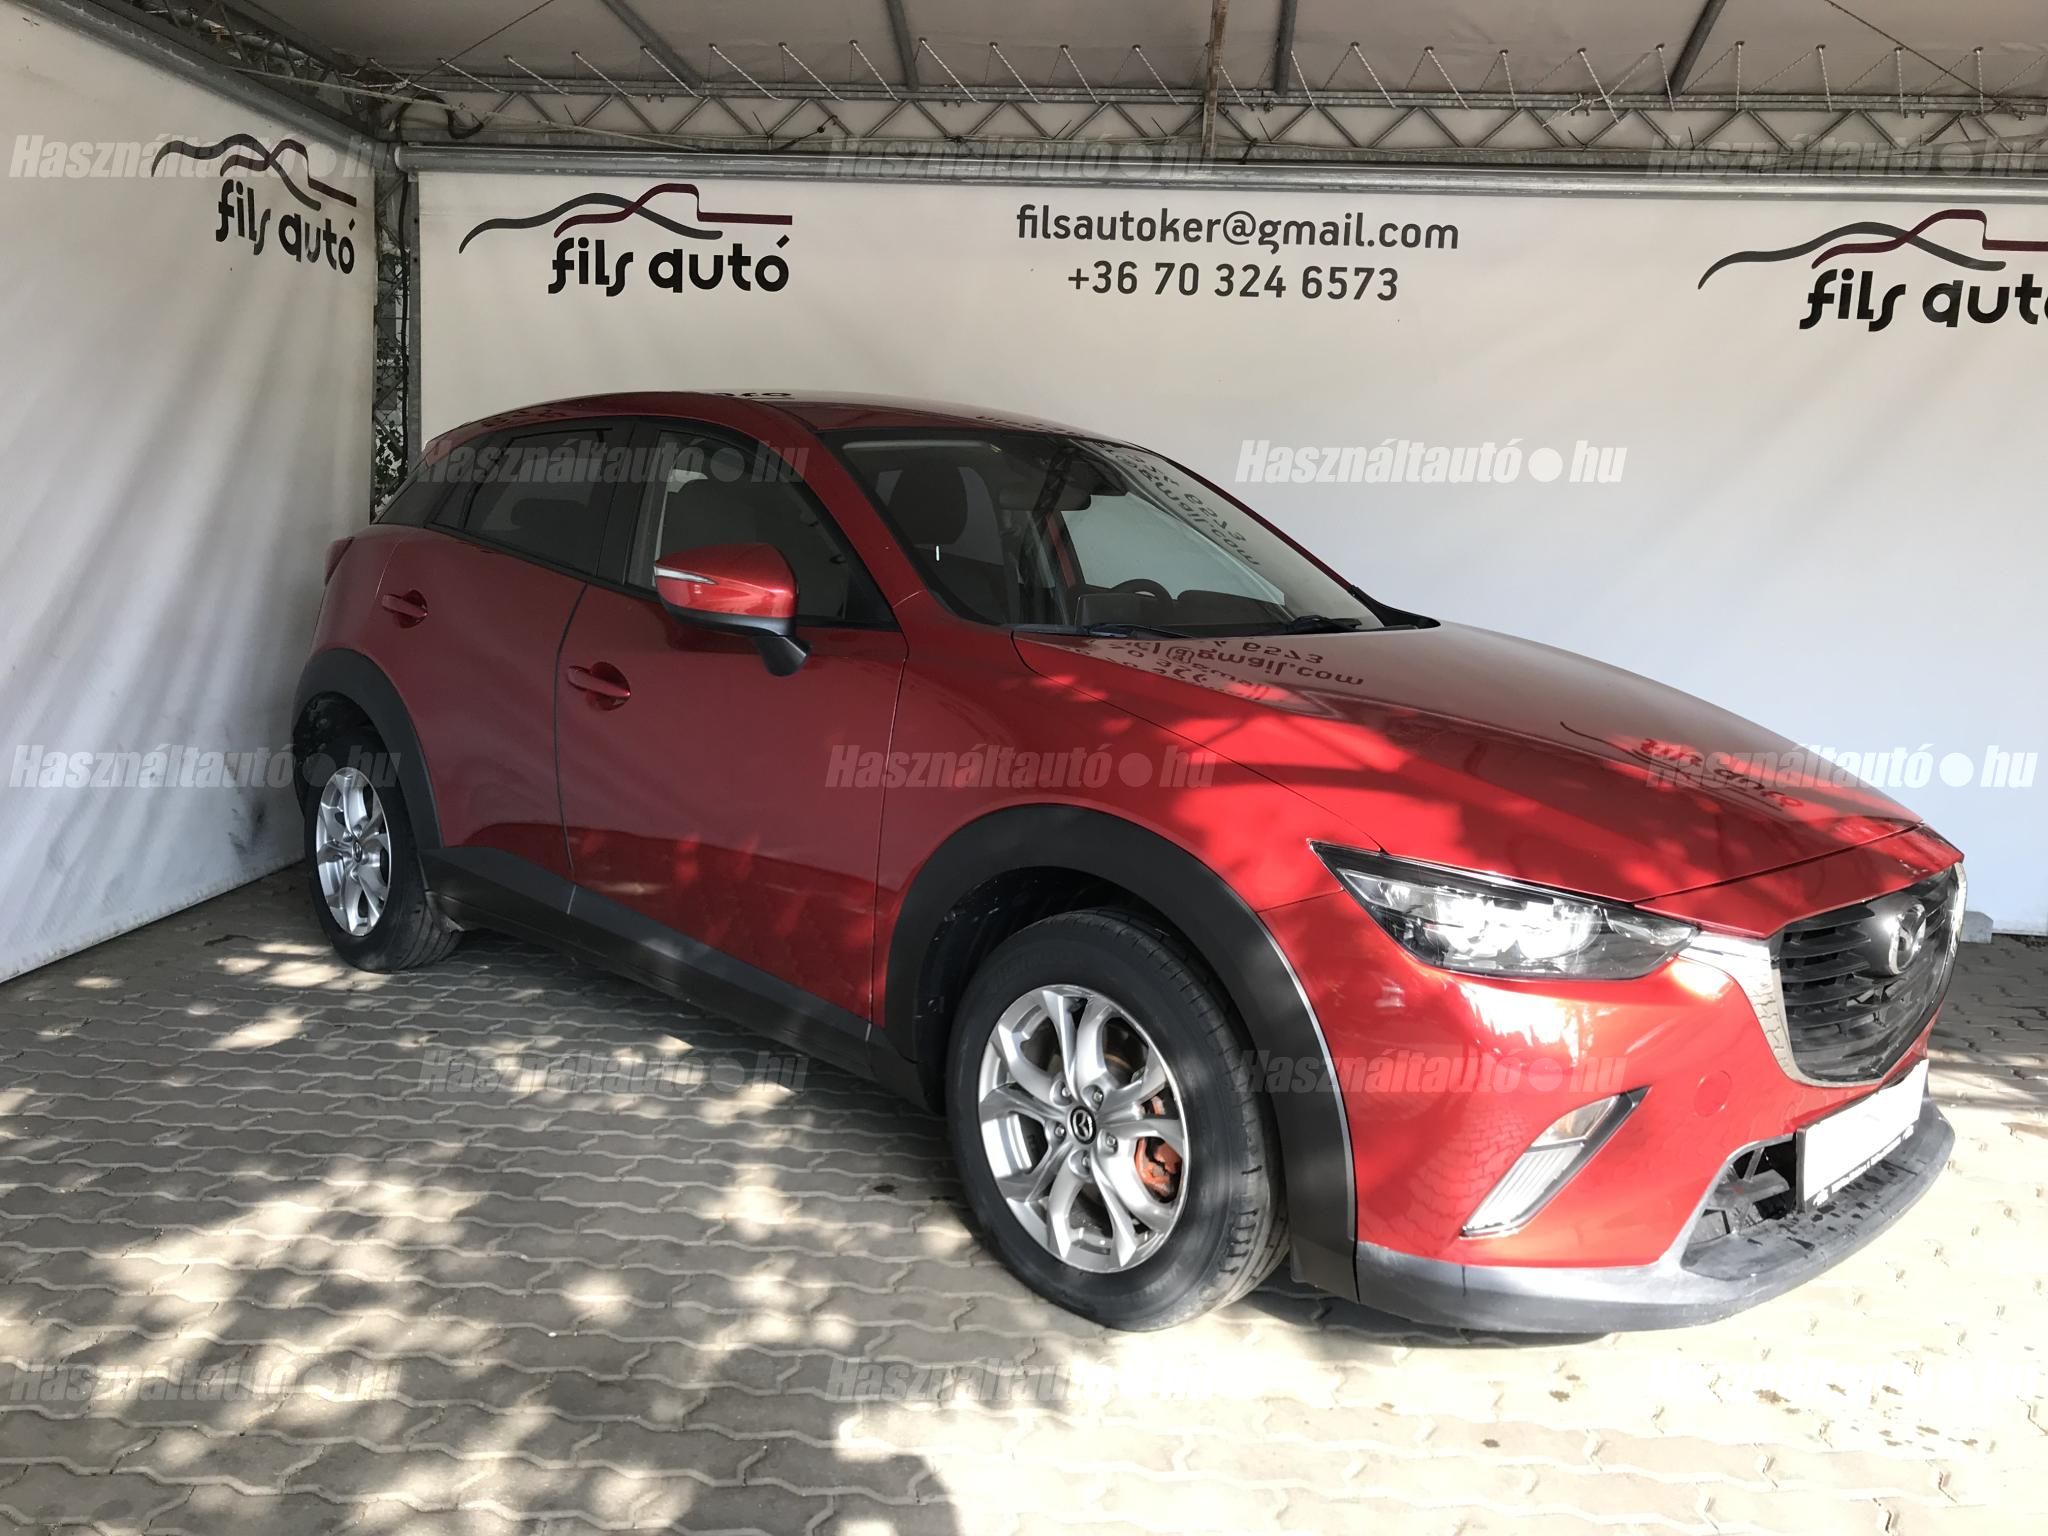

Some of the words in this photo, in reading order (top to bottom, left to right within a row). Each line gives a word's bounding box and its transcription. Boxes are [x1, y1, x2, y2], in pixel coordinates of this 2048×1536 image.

[215, 178, 272, 256] fils
[278, 213, 357, 275] autó
[1016, 203, 1459, 255] filsautoker@gmail.com
[547, 237, 634, 297] fils
[648, 234, 790, 294] autó
[1067, 260, 1138, 295] +36
[1154, 262, 1200, 296] 70
[1214, 263, 1287, 298] 324
[1301, 265, 1399, 301] 6573
[1799, 268, 1907, 332] fils
[1922, 273, 2048, 328] aut
